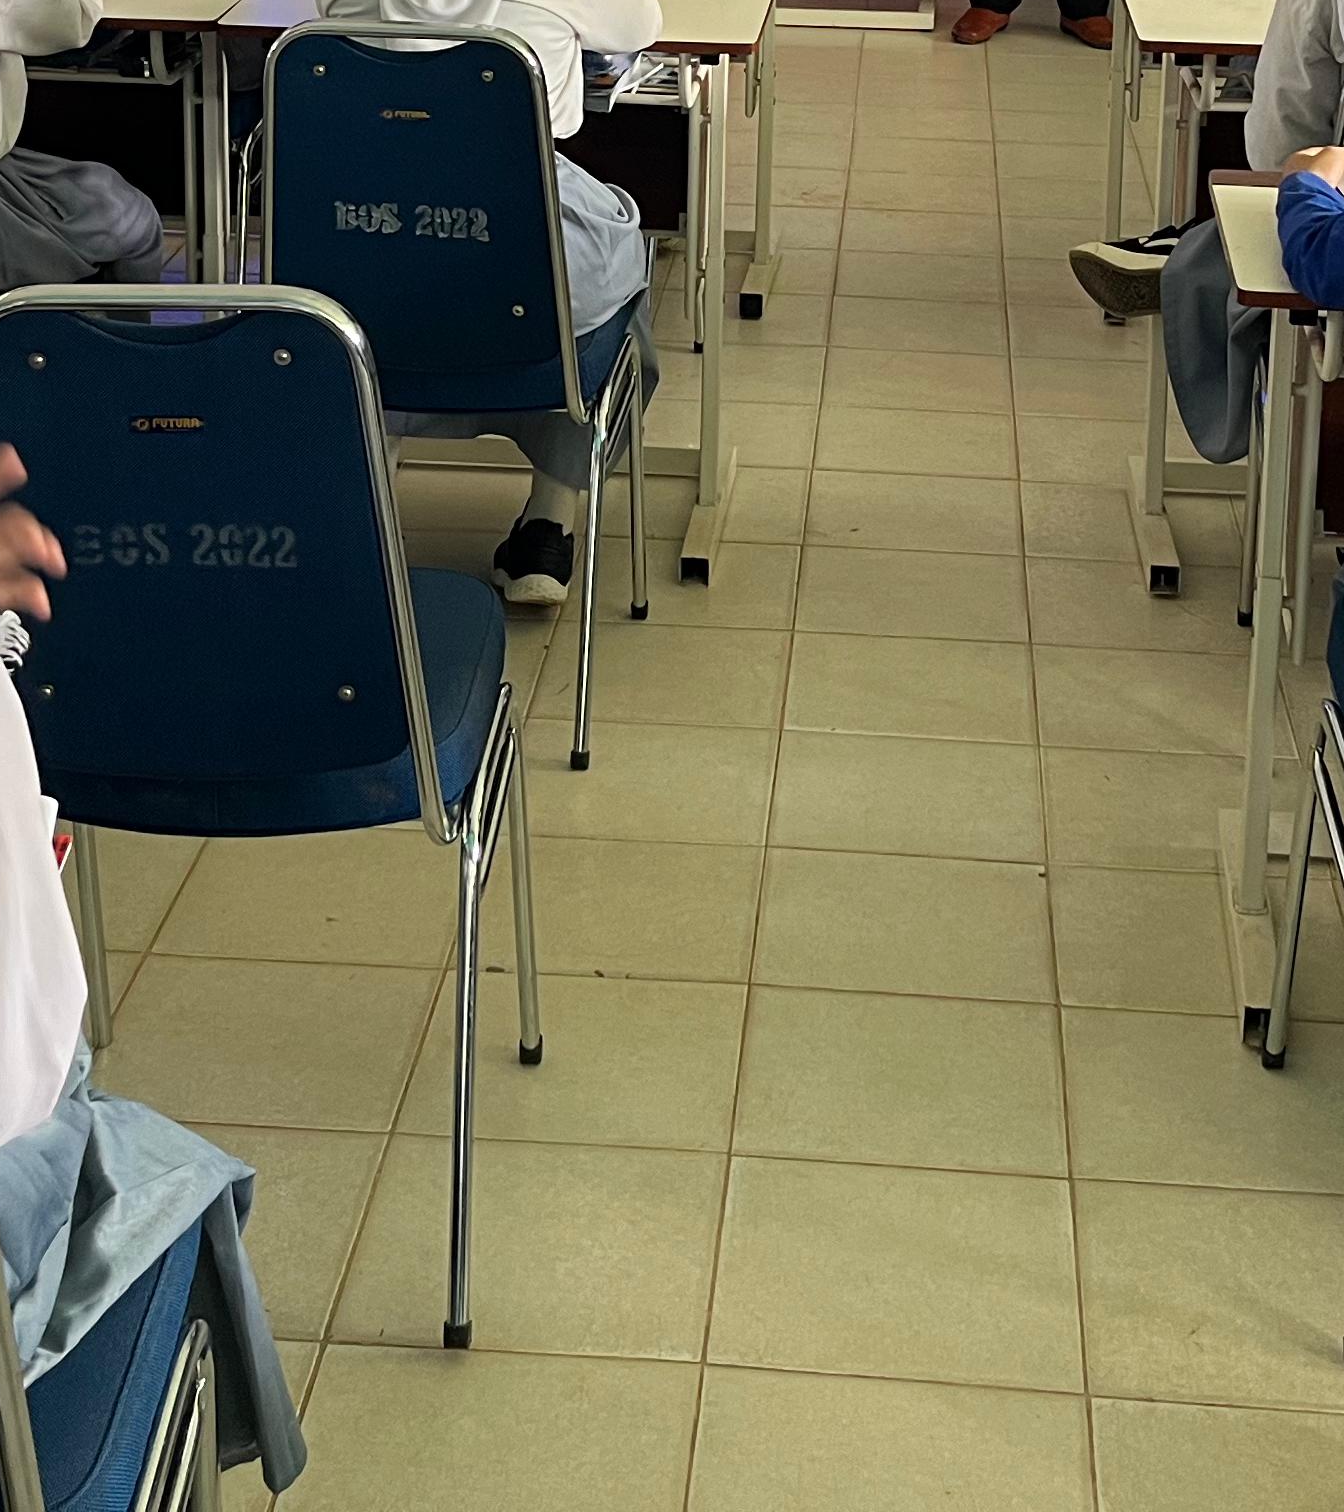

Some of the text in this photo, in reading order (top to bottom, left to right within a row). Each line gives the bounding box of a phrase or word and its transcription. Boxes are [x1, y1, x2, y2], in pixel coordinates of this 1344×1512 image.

[333, 200, 491, 243] BOS 2022
[71, 522, 299, 568] BOS 2022
